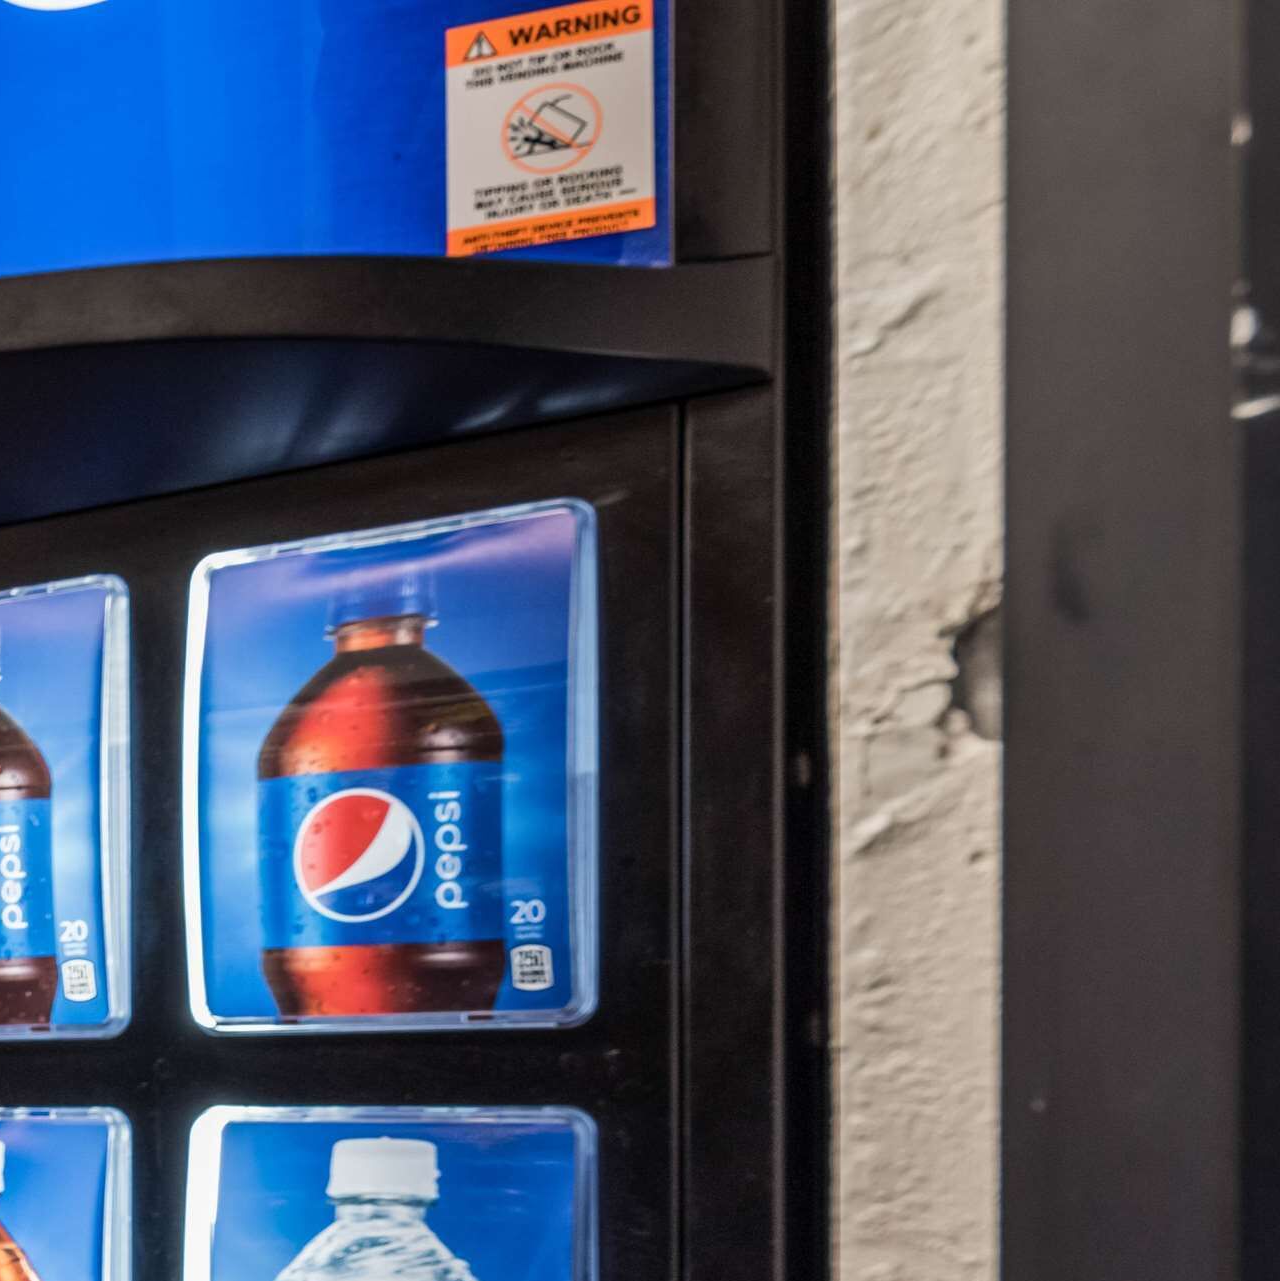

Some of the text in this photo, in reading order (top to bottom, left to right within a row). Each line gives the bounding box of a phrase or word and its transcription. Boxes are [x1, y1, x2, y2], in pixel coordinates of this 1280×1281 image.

[509, 5, 641, 46] WARNING
[428, 790, 469, 910] pepsi
[510, 899, 546, 924] 20
[59, 920, 88, 942] 20
